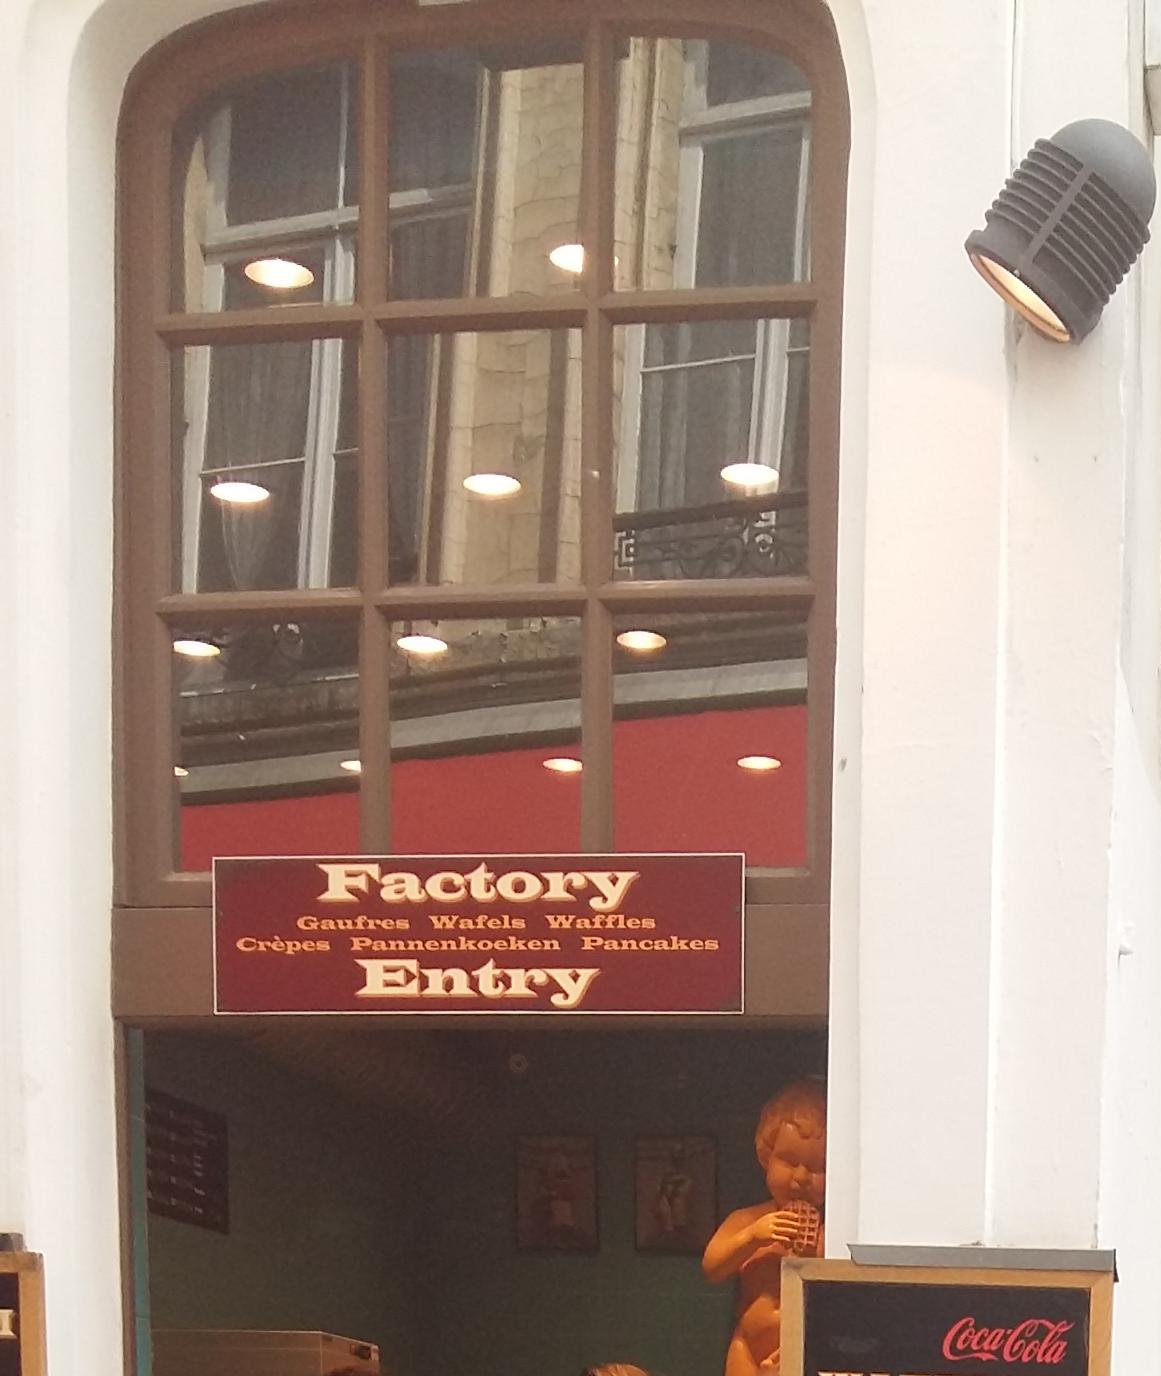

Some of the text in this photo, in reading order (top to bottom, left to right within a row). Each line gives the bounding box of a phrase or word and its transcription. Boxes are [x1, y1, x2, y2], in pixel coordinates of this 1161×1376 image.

[316, 861, 641, 912] Factory
[296, 914, 656, 931] Gaufres Wafels Waffles
[350, 935, 561, 951] Pannenkoeken
[581, 935, 720, 951] Pancakes
[354, 957, 601, 1009] Entry
[942, 1316, 1076, 1364] Coca-Cola
